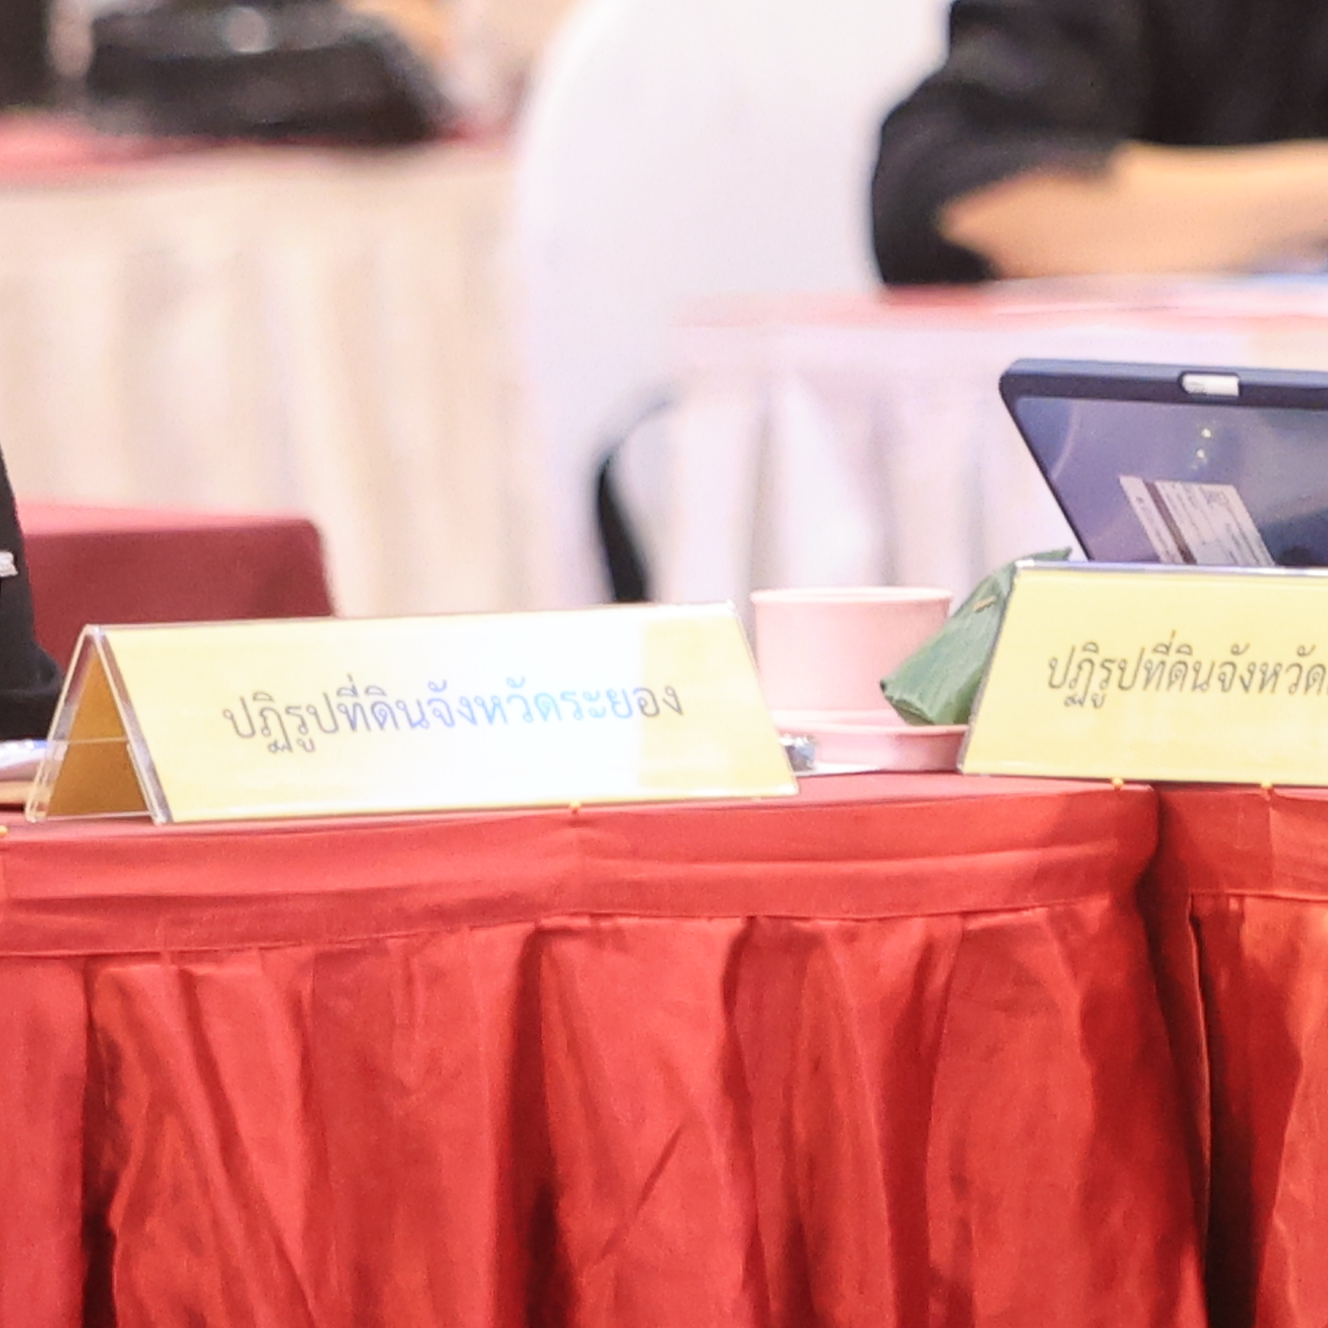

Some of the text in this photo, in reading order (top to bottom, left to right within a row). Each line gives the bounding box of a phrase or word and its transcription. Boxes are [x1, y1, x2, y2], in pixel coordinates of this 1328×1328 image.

[222, 674, 685, 754] ปฏิรูปที่ดินจังหวัดระยอง
